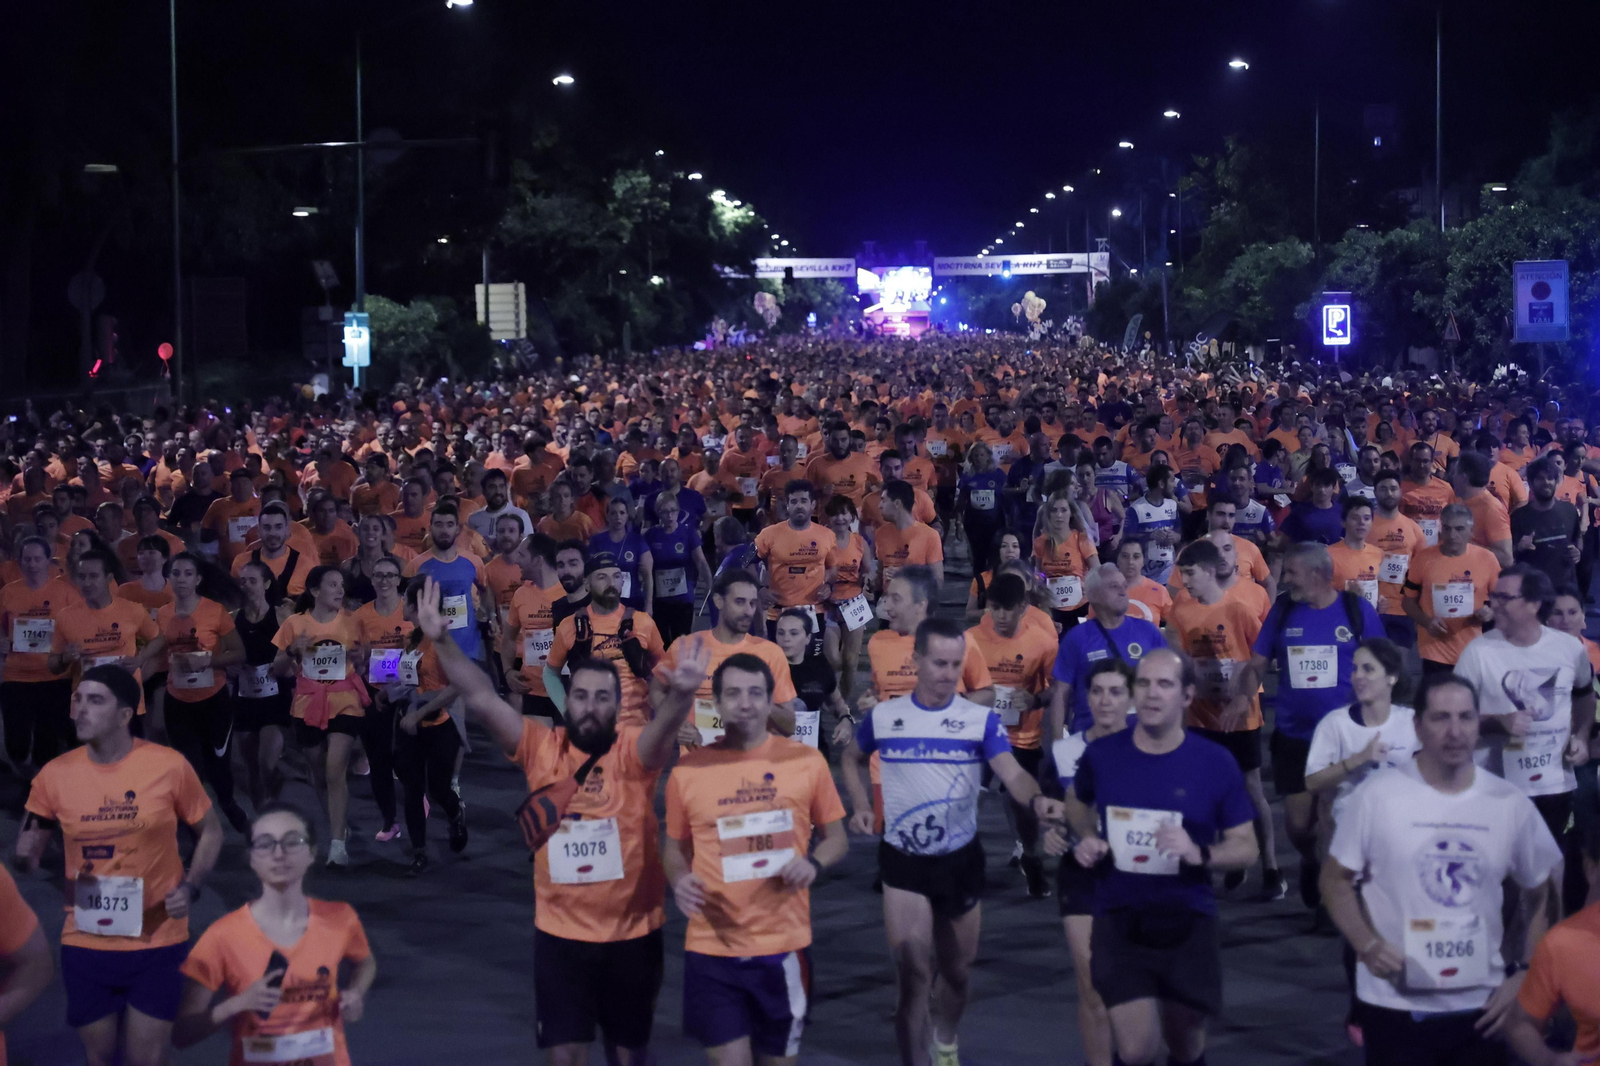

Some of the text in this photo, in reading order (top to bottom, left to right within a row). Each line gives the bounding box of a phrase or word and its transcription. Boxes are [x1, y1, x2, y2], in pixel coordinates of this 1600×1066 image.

[1055, 585, 1073, 595] 2800
[1443, 594, 1464, 605] 9162
[22, 630, 48, 639] 17147
[311, 656, 339, 668] 10074
[1299, 659, 1329, 671] 17380
[940, 717, 966, 730] ACS
[1517, 753, 1552, 770] 18267
[98, 805, 140, 814] NOCTURNA
[80, 812, 117, 823] SEVILLA
[745, 833, 775, 852] 786
[563, 840, 608, 859] 13078
[86, 894, 130, 912] 16373
[1425, 939, 1475, 959] 18266
